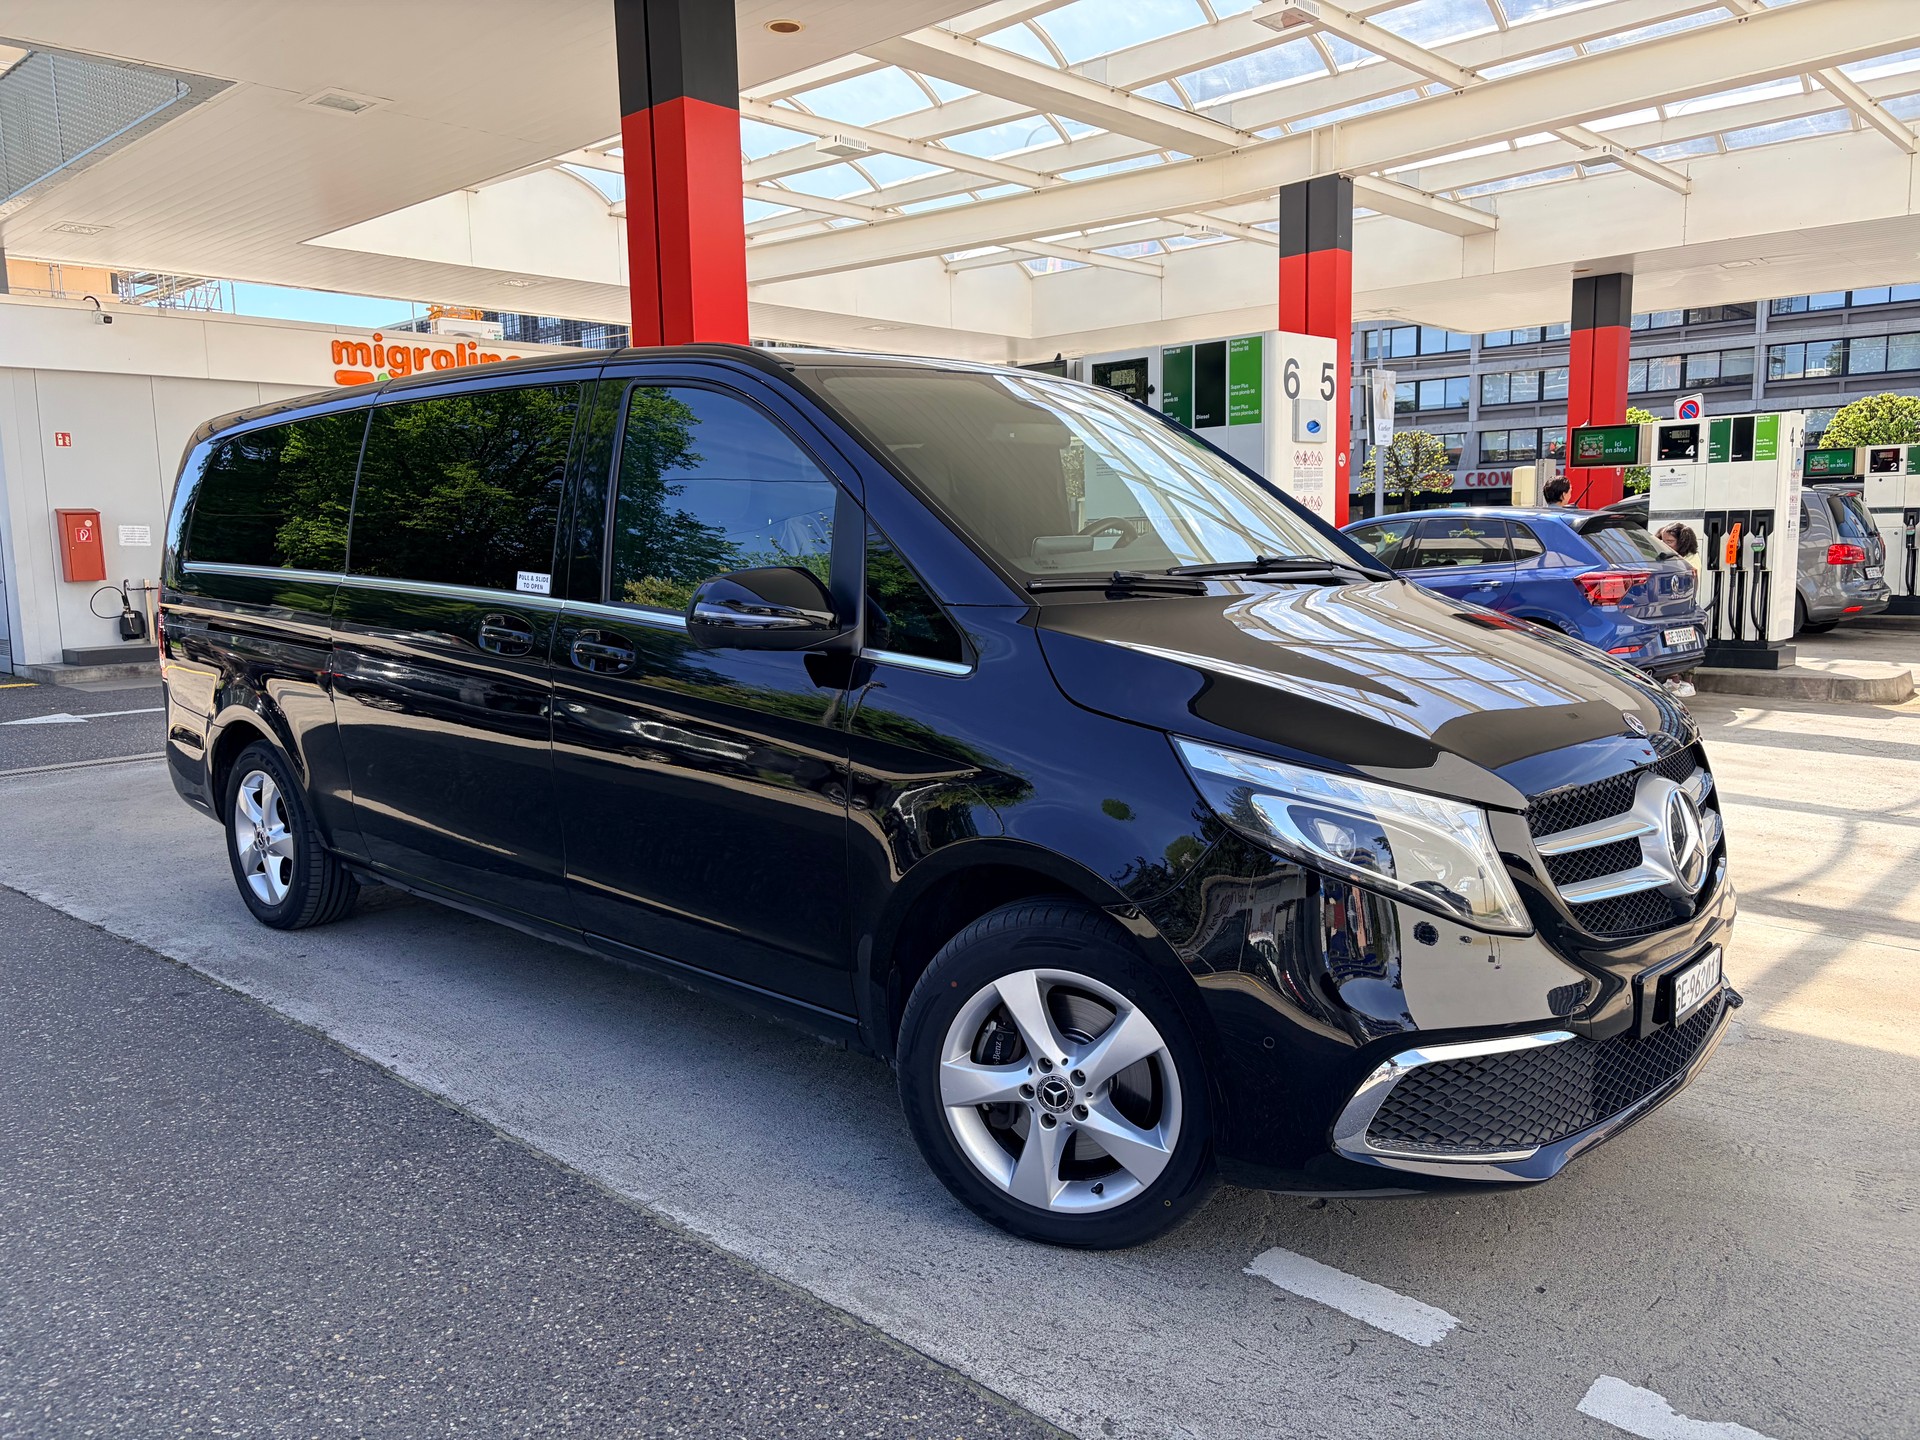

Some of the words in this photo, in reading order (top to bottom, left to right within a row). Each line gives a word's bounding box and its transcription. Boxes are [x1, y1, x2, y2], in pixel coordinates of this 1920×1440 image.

[331, 332, 523, 378] migrolin
[1283, 357, 1301, 400] 6
[1320, 362, 1335, 402] 5
[1789, 426, 1795, 448] 4
[1799, 428, 1804, 448] 3
[1685, 444, 1696, 457] 4
[1890, 462, 1898, 471] 2
[1465, 471, 1513, 488] CROW
[518, 573, 530, 581] PULL
